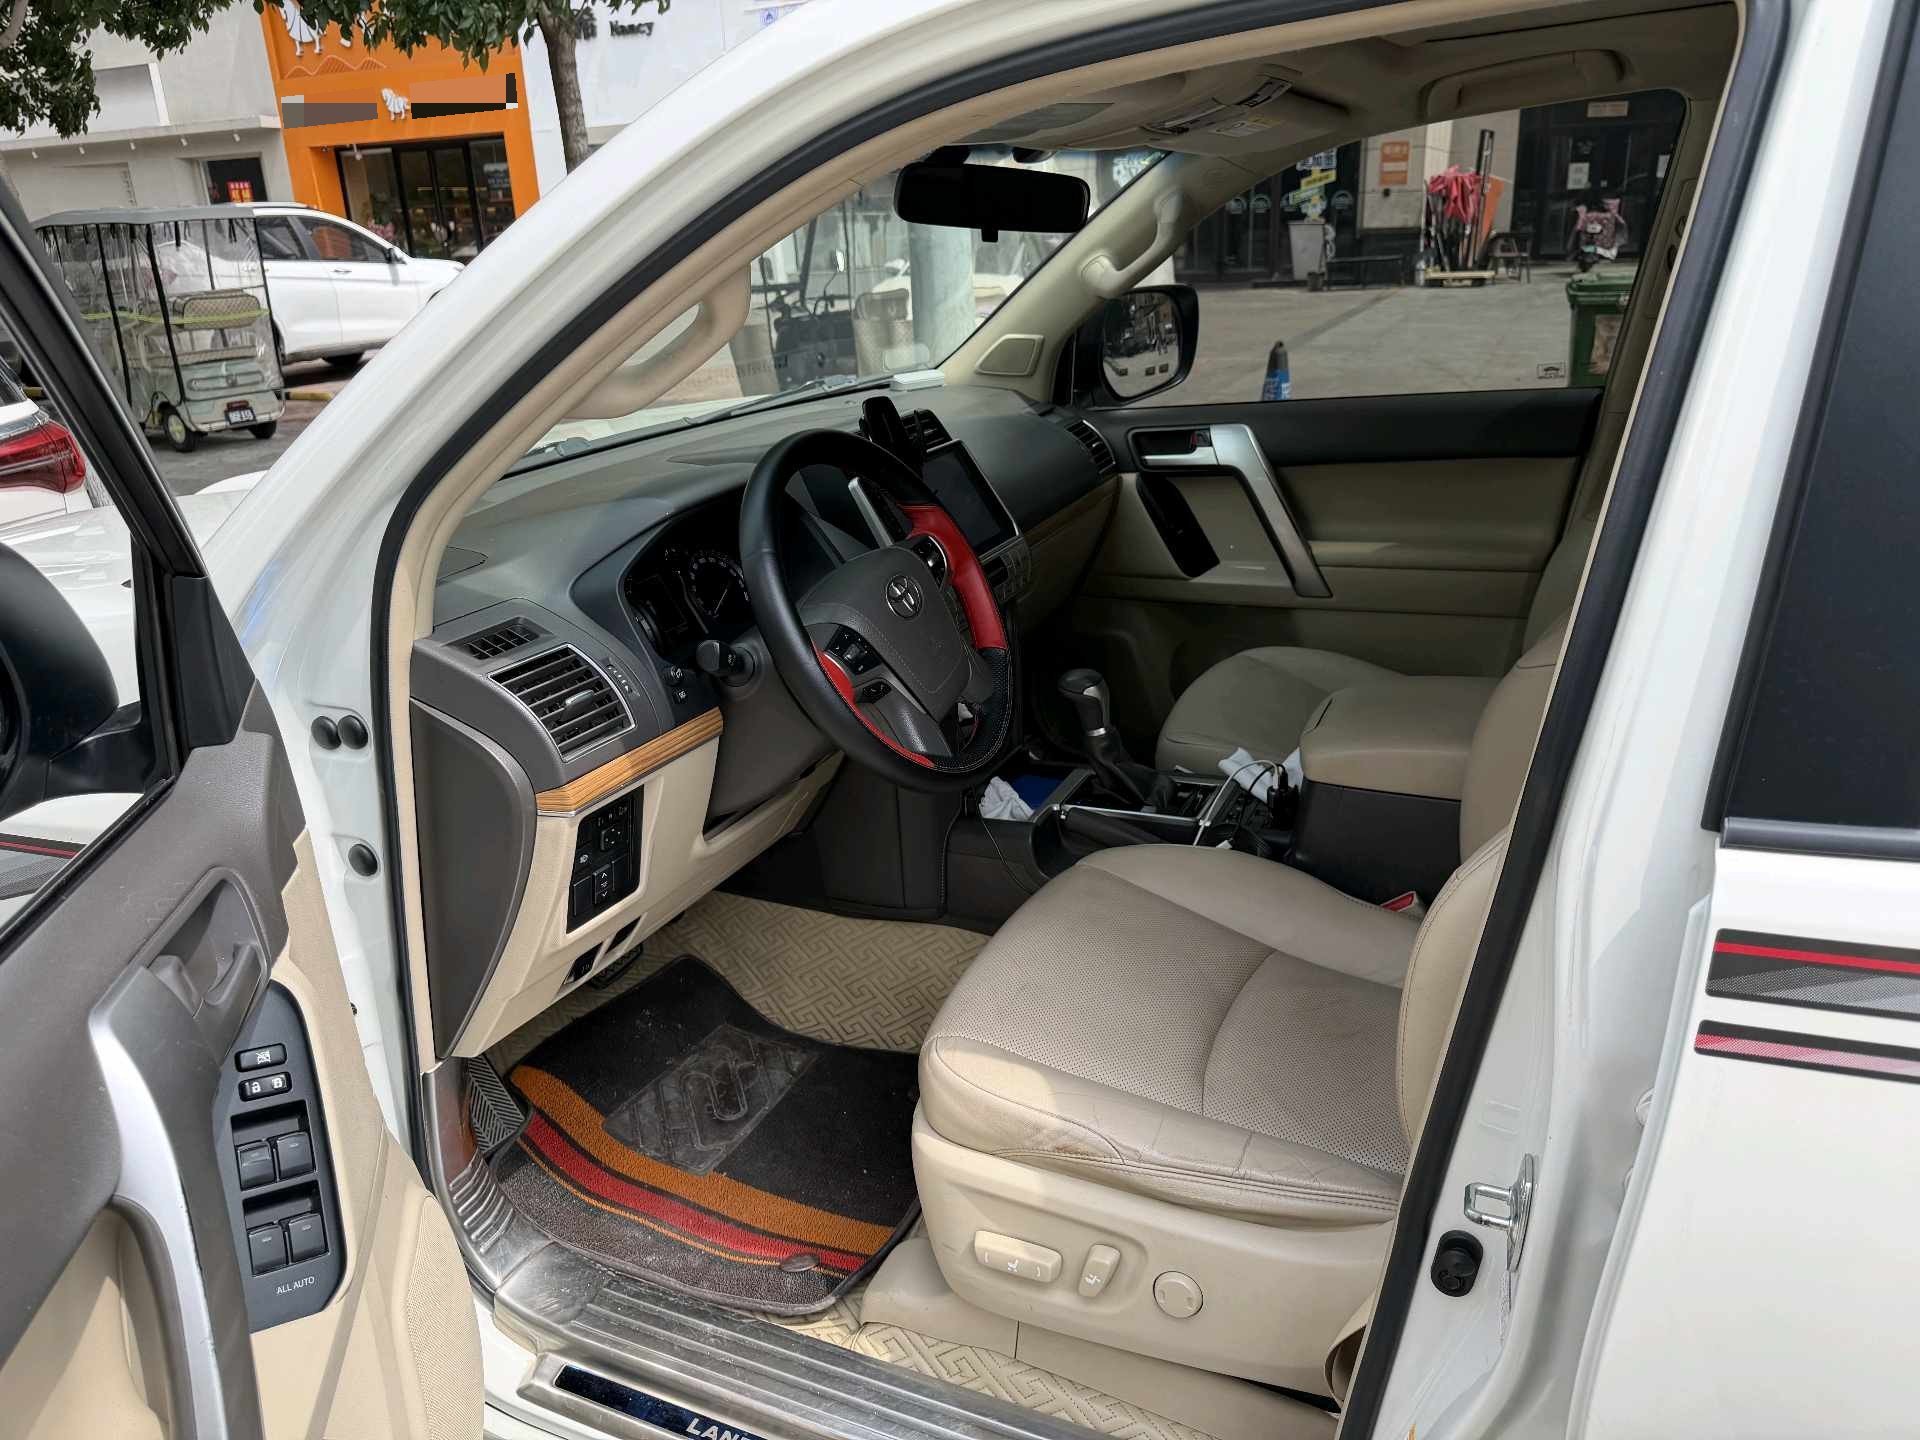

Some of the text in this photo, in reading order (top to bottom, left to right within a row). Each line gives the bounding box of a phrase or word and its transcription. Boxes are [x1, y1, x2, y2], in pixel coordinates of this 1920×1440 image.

[276, 1276, 315, 1295] ALL AUTO
[686, 1418, 751, 1440] LAN
